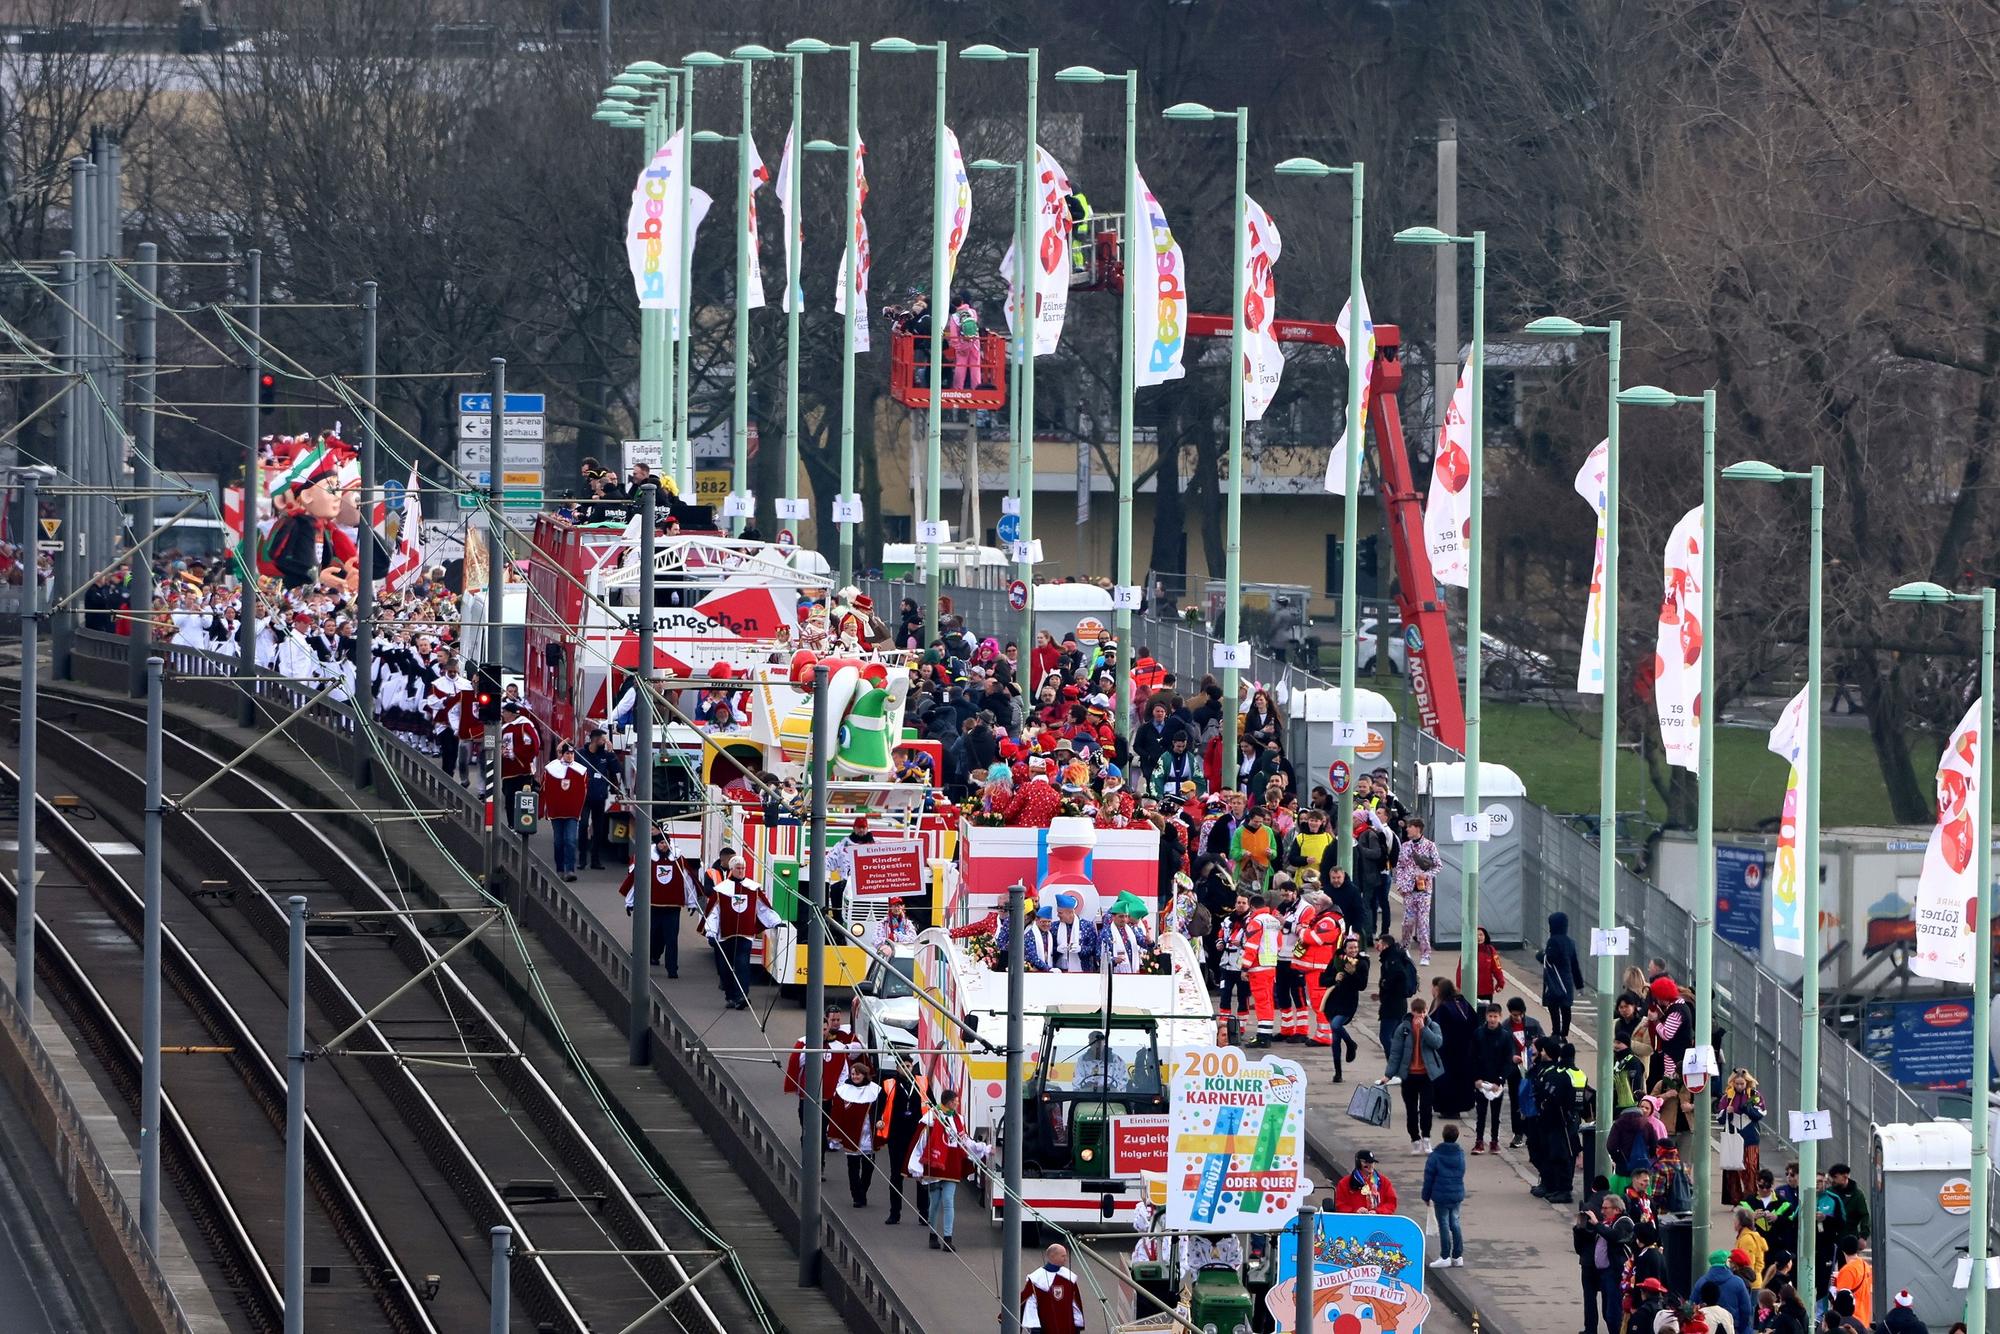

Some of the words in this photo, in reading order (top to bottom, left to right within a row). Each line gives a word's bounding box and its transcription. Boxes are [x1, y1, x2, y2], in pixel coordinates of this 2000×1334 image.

[736, 502, 746, 511] 10
[785, 505, 796, 513] 11
[842, 508, 852, 516] 12
[926, 528, 937, 537] 13
[1019, 546, 1028, 556] 14
[1120, 593, 1131, 602] 15
[627, 611, 758, 634] Hnneschen
[1224, 652, 1235, 661] 16
[1343, 729, 1354, 737] 17
[1465, 822, 1477, 832] 18
[866, 846, 907, 854] Einleitung
[862, 862, 912, 871] Dreigestirn
[1608, 936, 1617, 945] 19
[1184, 1052, 1239, 1078] 200
[1240, 1069, 1272, 1079] JAHRE
[1204, 1075, 1262, 1093] KÖLNER
[1186, 1091, 1266, 1106] KARNEVAL
[1129, 1117, 1169, 1125] Einleitun
[1804, 1119, 1817, 1131] 21
[1120, 1150, 1152, 1159] Holger
[1204, 1158, 1224, 1197] KRÜZZ
[1225, 1177, 1258, 1189] ODER
[1262, 1175, 1294, 1189] QUER
[1317, 1267, 1380, 1288] JUBILÄUMS-
[1353, 1285, 1377, 1296] ZOCH
[1380, 1287, 1405, 1302] KÜTT
